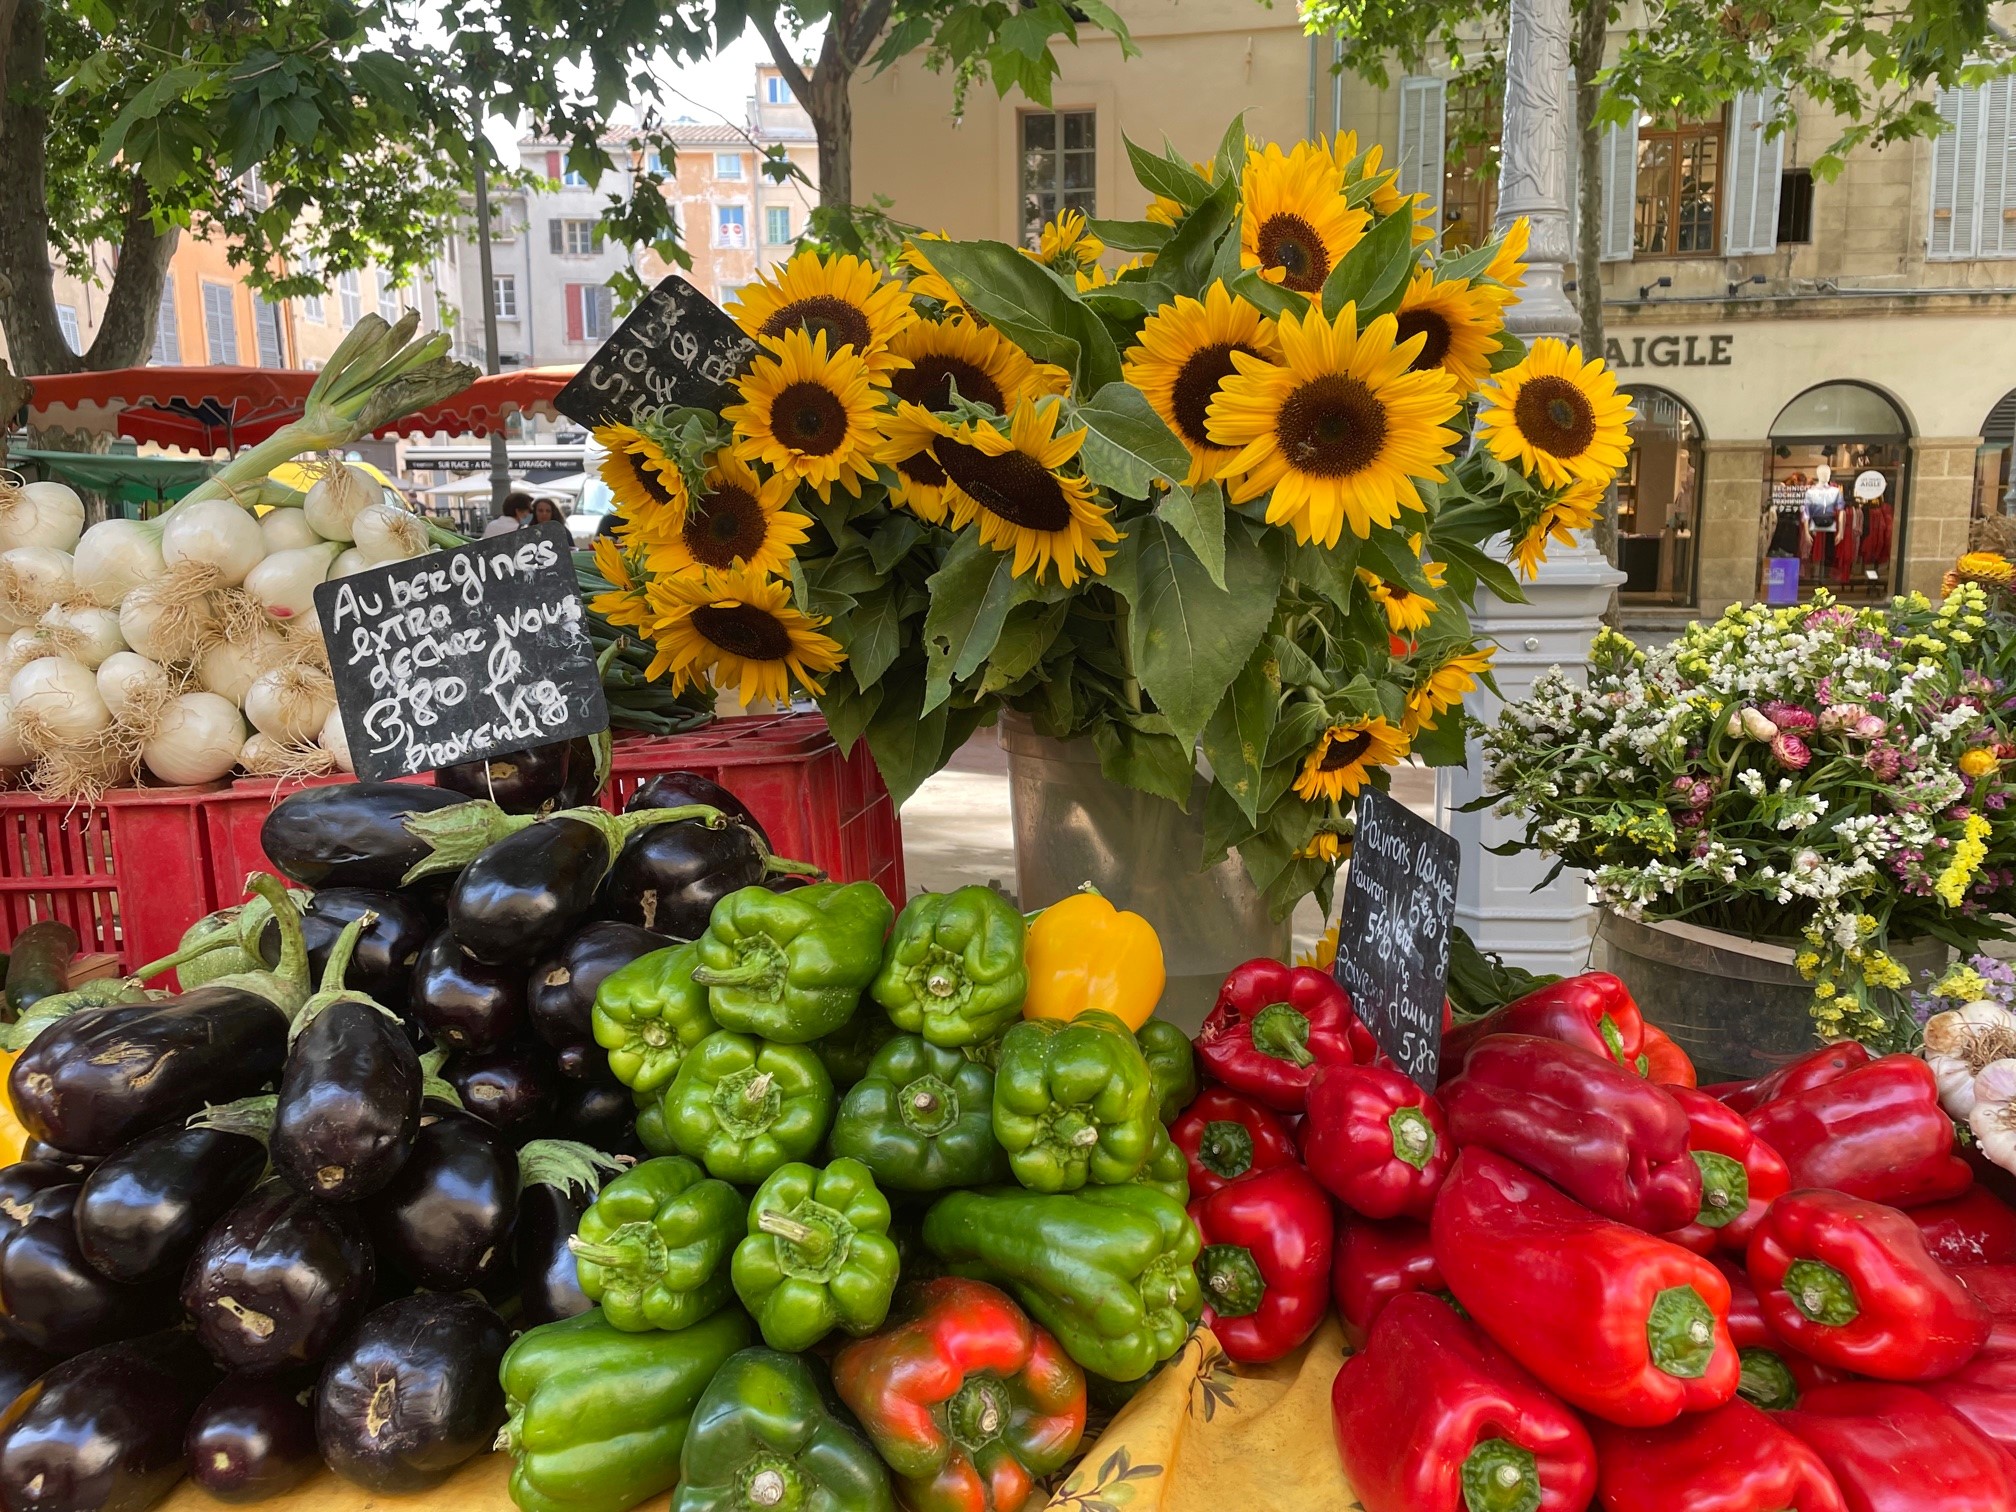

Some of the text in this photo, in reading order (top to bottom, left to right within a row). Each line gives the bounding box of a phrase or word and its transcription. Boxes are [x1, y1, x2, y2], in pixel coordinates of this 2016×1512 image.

[1605, 334, 1733, 368] AIGLE
[519, 460, 551, 469] LIVRAISON
[1361, 794, 1411, 875] Poivrons
[1351, 851, 1388, 909] Poivrons
